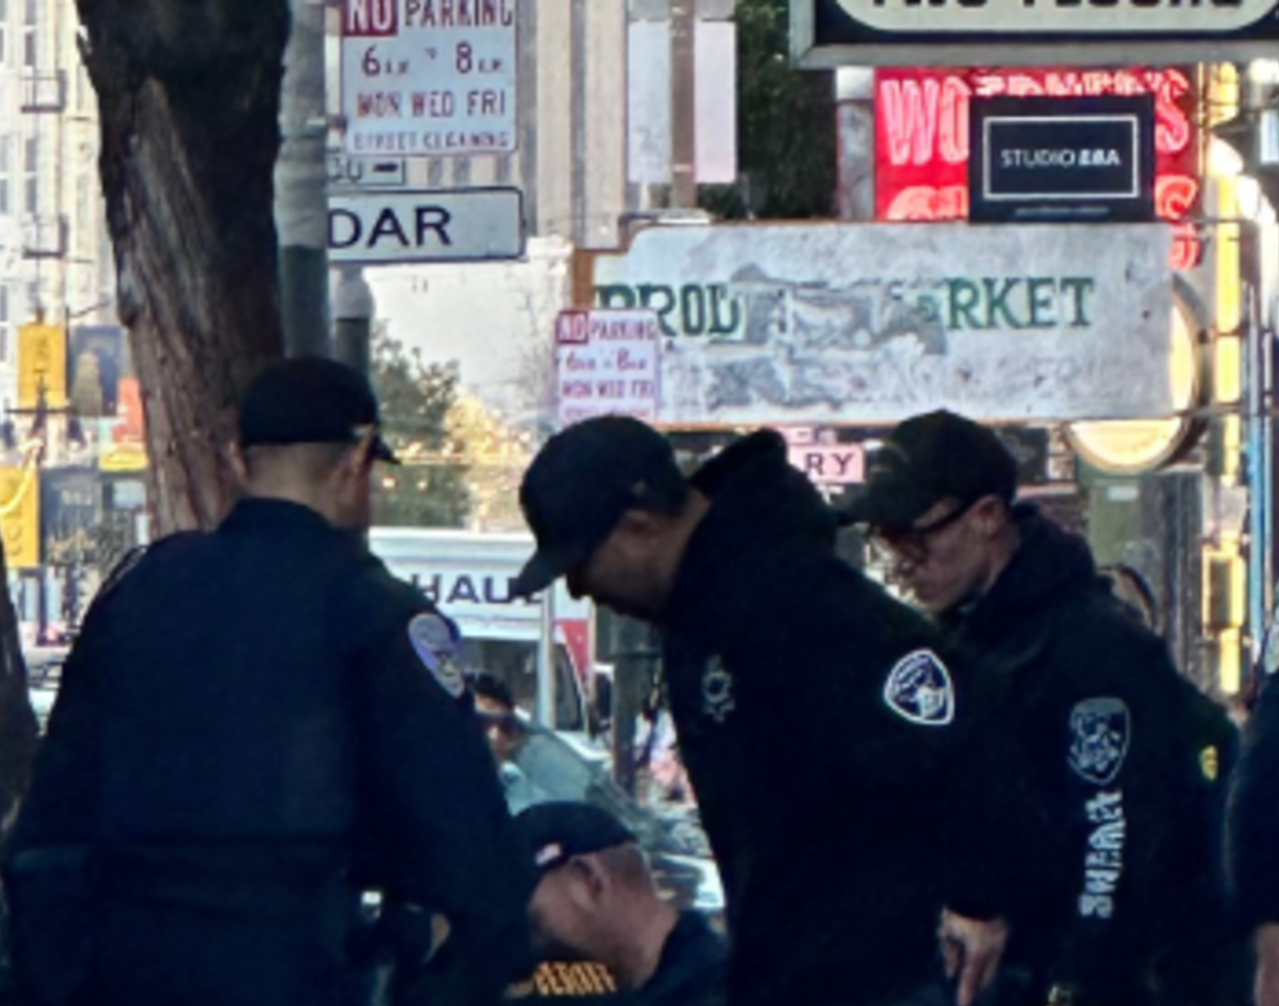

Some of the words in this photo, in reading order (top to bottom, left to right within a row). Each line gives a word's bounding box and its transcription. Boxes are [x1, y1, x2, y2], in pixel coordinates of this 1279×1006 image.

[347, 0, 394, 33] NO
[404, 0, 513, 28] PARKING
[357, 91, 402, 119] MON
[411, 90, 455, 118] WED
[467, 89, 505, 117] FRI
[1000, 149, 1075, 168] STUDIO
